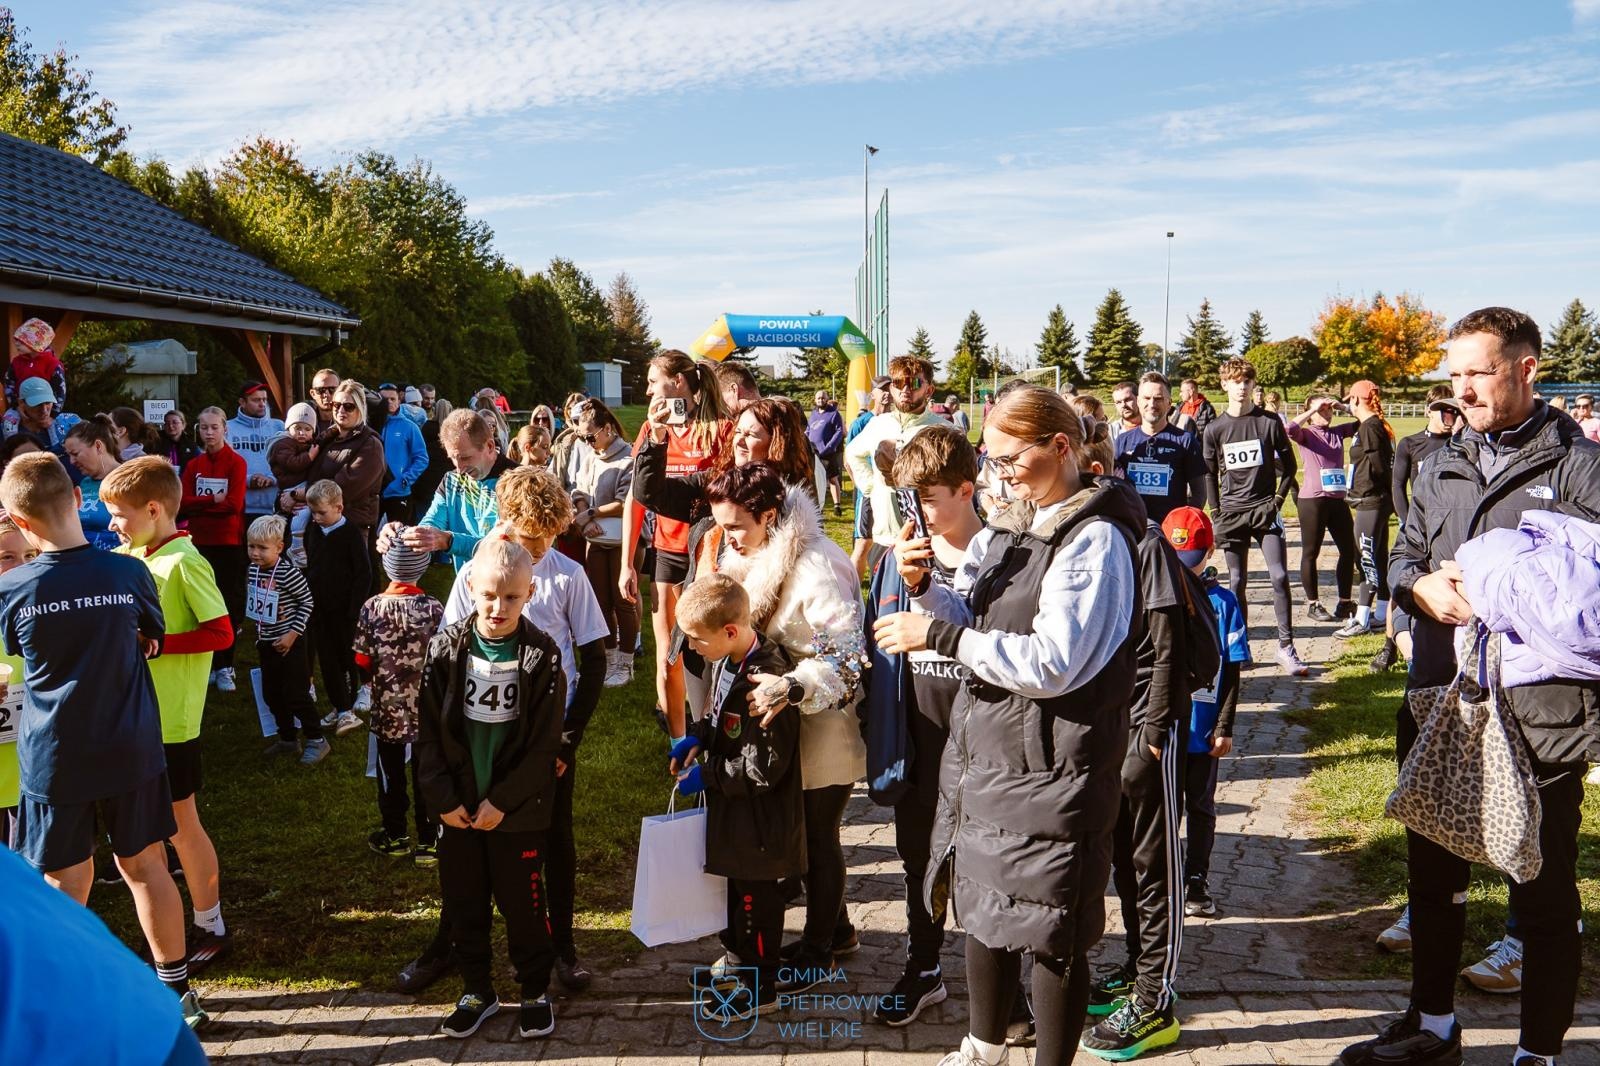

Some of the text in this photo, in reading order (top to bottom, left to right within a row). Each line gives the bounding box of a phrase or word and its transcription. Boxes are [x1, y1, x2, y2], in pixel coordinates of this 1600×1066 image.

[759, 320, 810, 330] POWIAT
[747, 333, 821, 343] RACIBORSKI
[1227, 449, 1259, 465] 307
[1135, 472, 1161, 486] 183
[1330, 474, 1343, 485] 15
[19, 594, 134, 618] JUNIOR TRENING
[248, 597, 274, 618] 321
[464, 679, 519, 712] 249
[1132, 1016, 1165, 1039] KIPRUN
